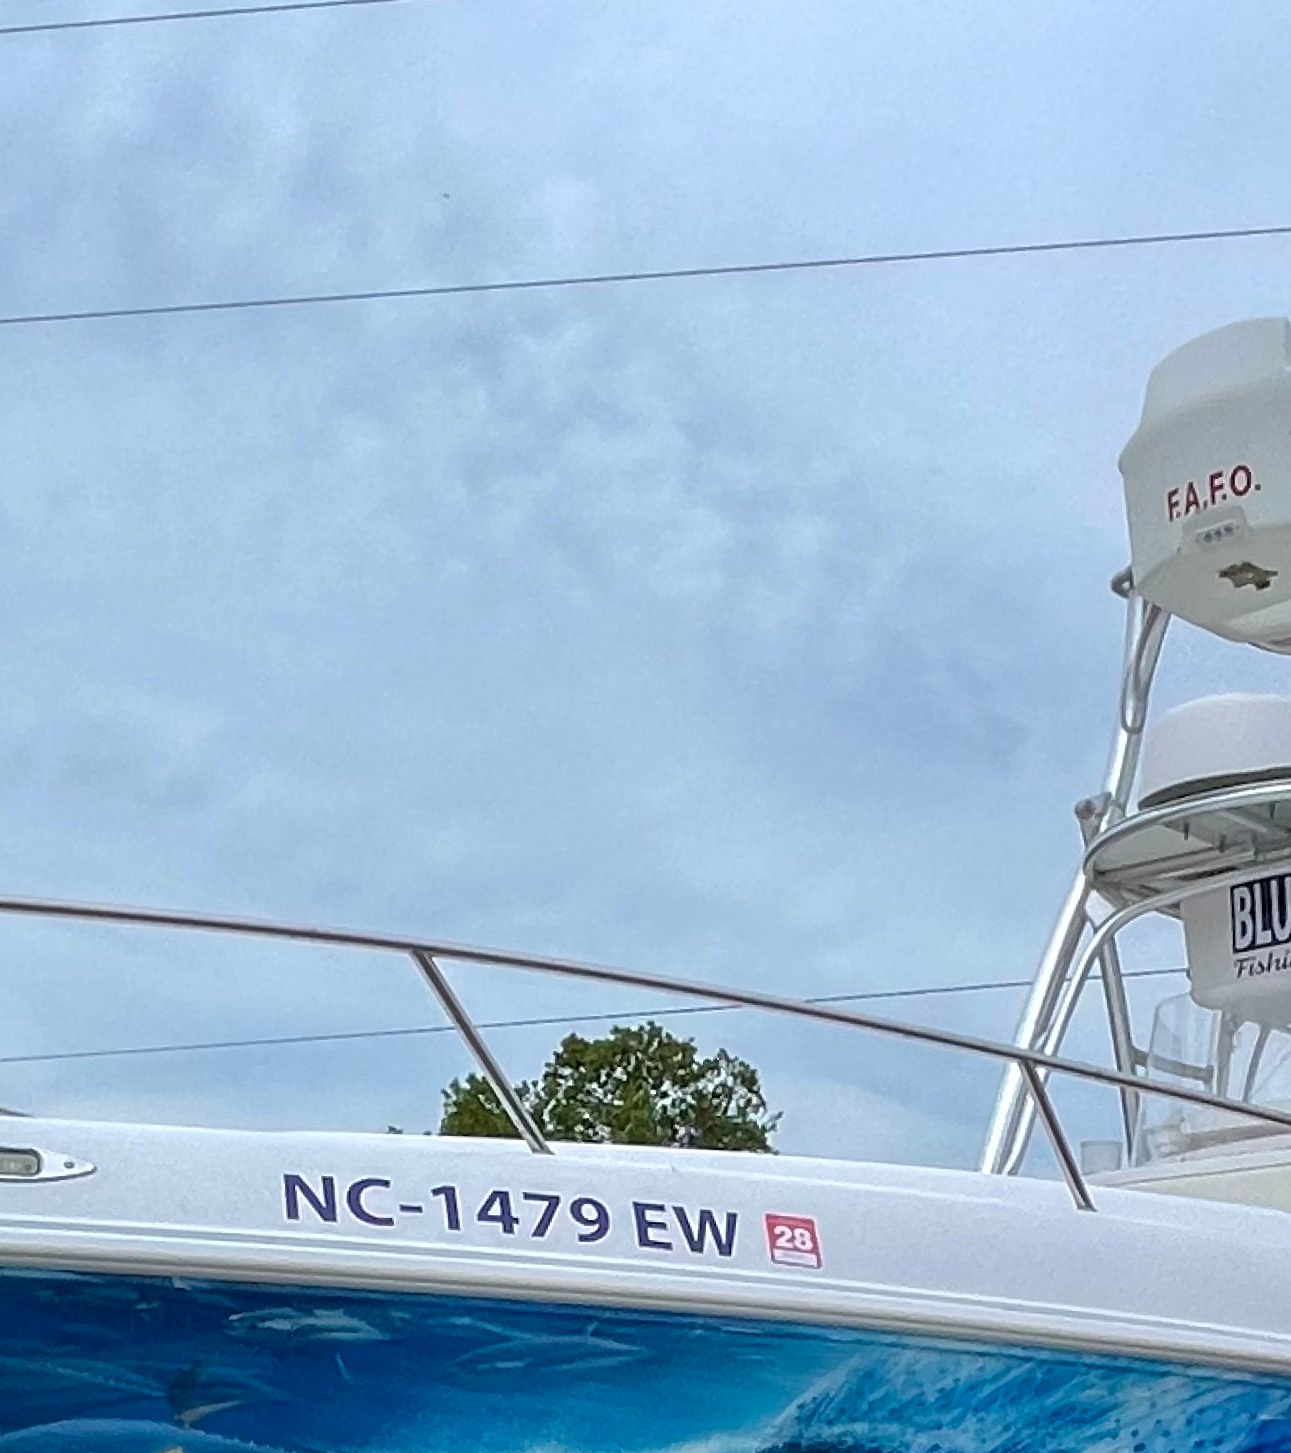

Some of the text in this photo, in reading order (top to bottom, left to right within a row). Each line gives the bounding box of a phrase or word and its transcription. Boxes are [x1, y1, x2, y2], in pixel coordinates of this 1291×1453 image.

[1167, 465, 1261, 522] F.A.F.O.
[283, 1173, 738, 1257] NC-1479 EW
[773, 1225, 814, 1251] 28
